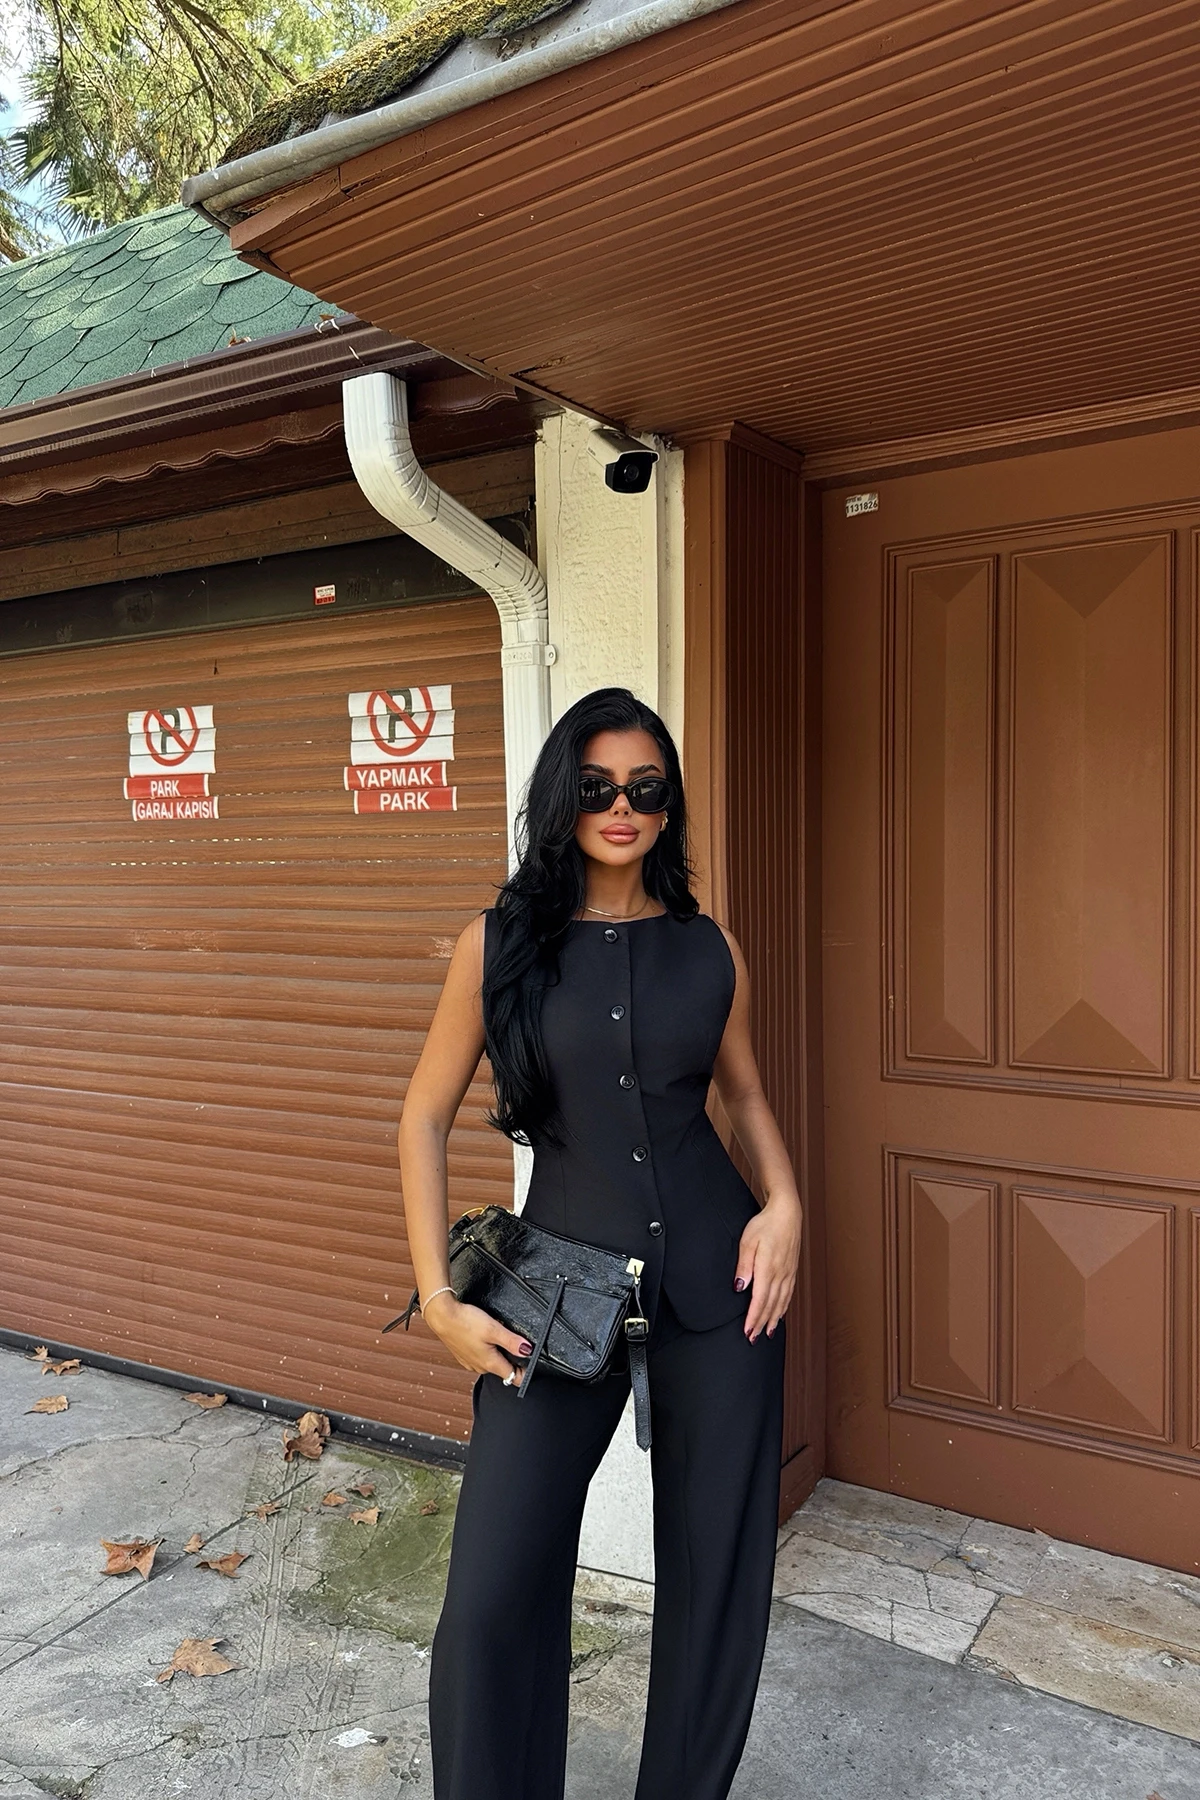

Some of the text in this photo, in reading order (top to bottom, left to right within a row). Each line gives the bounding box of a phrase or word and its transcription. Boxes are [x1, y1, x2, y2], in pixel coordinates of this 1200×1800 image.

[846, 500, 878, 513] 1131826
[356, 766, 434, 788] YAPMAK
[150, 780, 180, 797] PARK
[137, 801, 212, 819] GARAJ KAPISI
[380, 791, 430, 811] PARK
